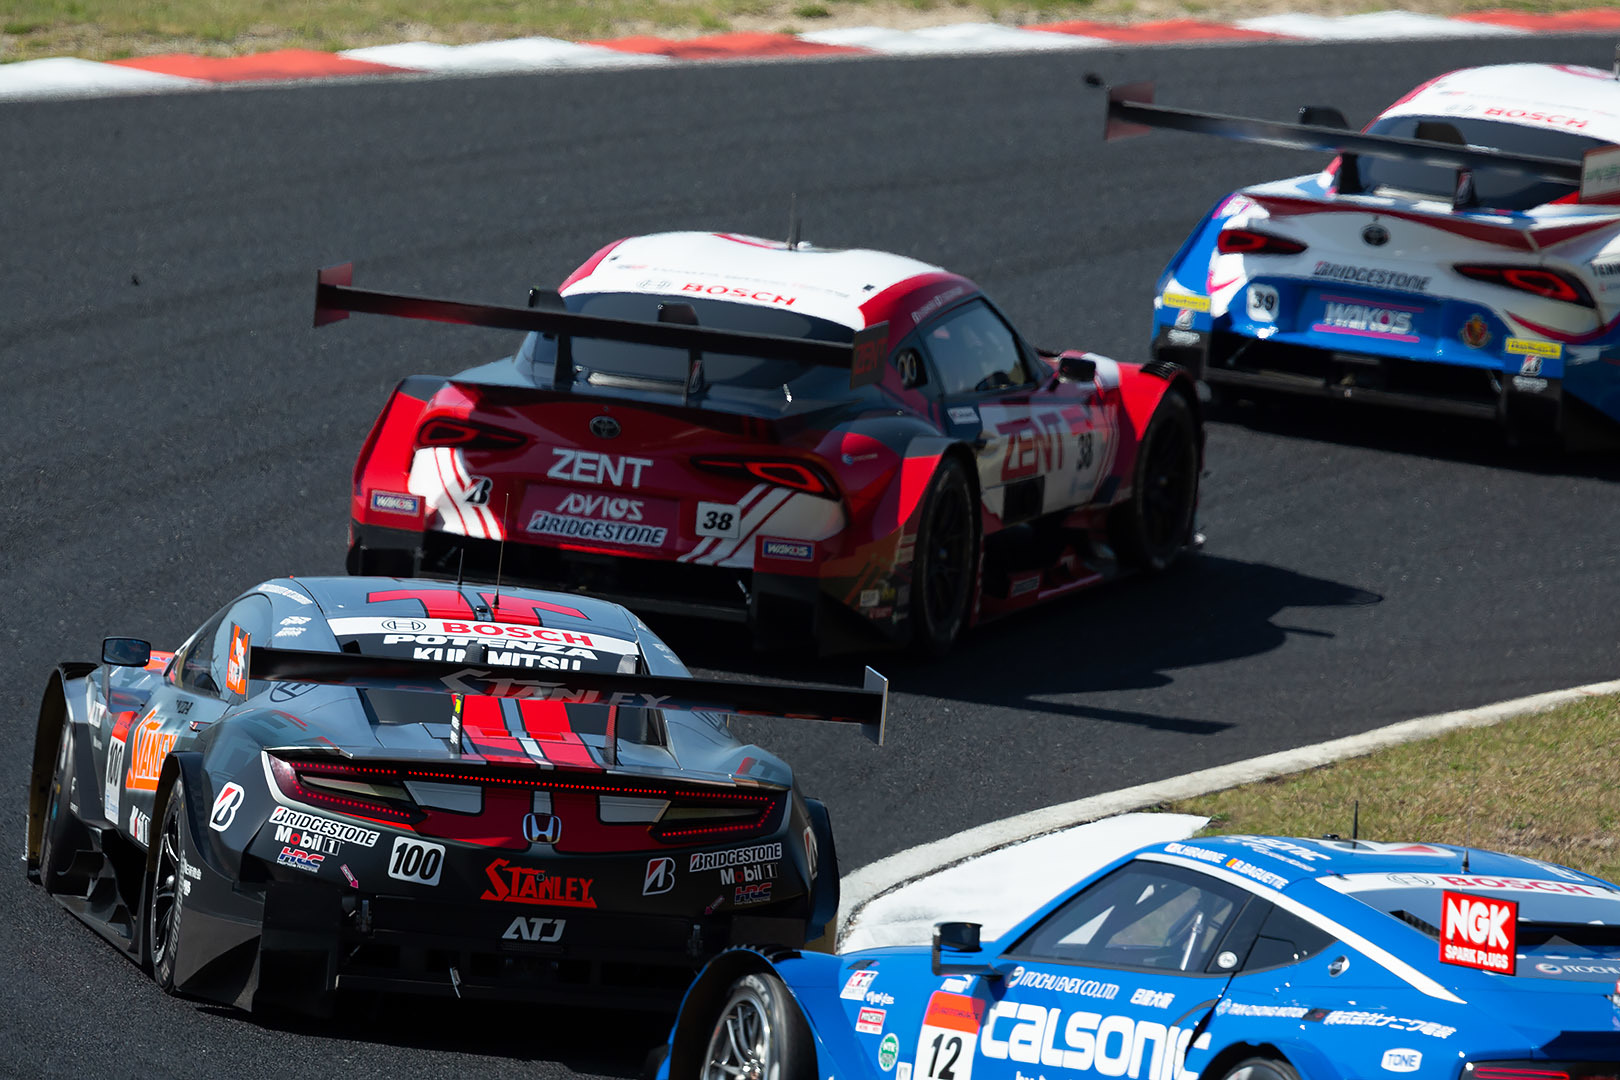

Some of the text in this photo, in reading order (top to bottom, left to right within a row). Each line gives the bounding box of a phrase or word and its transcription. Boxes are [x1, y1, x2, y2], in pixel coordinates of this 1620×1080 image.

[1484, 107, 1590, 128] BOSCH
[1313, 260, 1432, 292] BRIDGESTONE
[681, 282, 796, 306] BOSCH
[1252, 290, 1275, 311] 39
[996, 413, 1063, 481] ZENT
[1076, 433, 1092, 471] 38
[546, 448, 653, 488] ZENT
[527, 511, 667, 546] BRIDGESTONE
[703, 510, 735, 532] 38
[383, 633, 598, 660] POTENZA
[442, 621, 594, 647] BOSCH
[413, 647, 582, 671] KUMITSU
[107, 741, 124, 787] 100
[268, 806, 380, 848] BRIDGESTONE
[275, 825, 323, 851] Mobil
[277, 846, 325, 869] HRC
[391, 841, 443, 880] 100
[689, 842, 782, 873] BRIDGESTONE
[480, 857, 597, 909] STANLEY
[720, 864, 763, 886] Mobil
[1439, 876, 1595, 895] BOSCH
[734, 882, 772, 901] HRC
[502, 916, 567, 943] ATJ
[1445, 897, 1511, 951] NGK
[1444, 944, 1509, 970] SPARK PLUGS
[1020, 970, 1060, 990] ITOCHU
[1056, 976, 1084, 994] ENEX
[928, 1033, 963, 1080] 12
[1387, 1054, 1417, 1068] TONE
